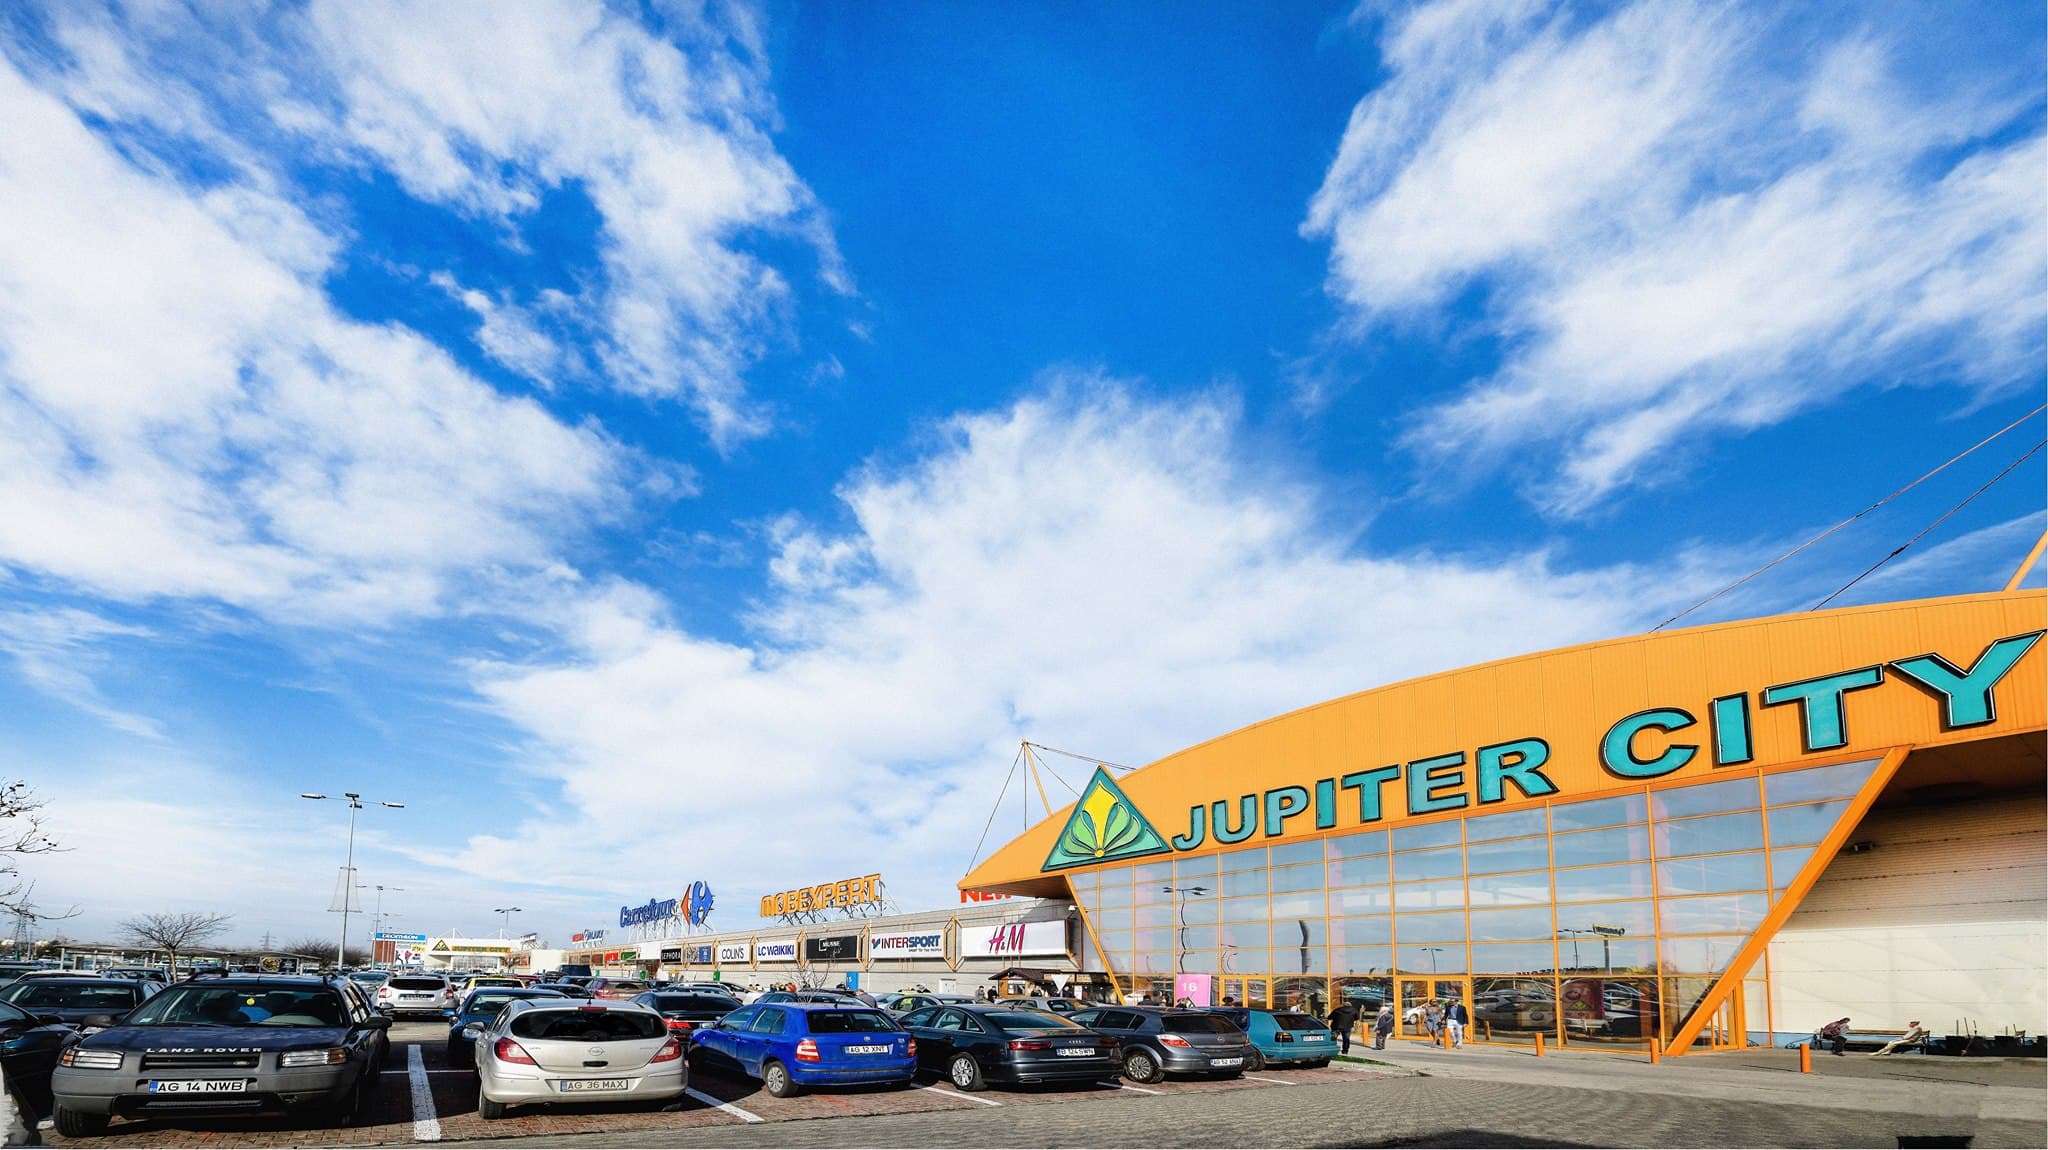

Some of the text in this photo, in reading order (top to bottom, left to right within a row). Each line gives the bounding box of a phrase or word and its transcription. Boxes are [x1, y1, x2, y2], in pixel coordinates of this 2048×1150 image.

[1172, 629, 2047, 852] JUPITER CITY
[620, 898, 676, 928] Carrefour
[881, 935, 941, 949] INTERSPORT
[989, 923, 1025, 955] H&M
[721, 947, 744, 960] COLIN'S
[757, 946, 767, 957] LC
[1183, 982, 1198, 992] 16
[158, 1082, 243, 1092] AG 14 NWB
[567, 1079, 624, 1089] AG 36 MAX
